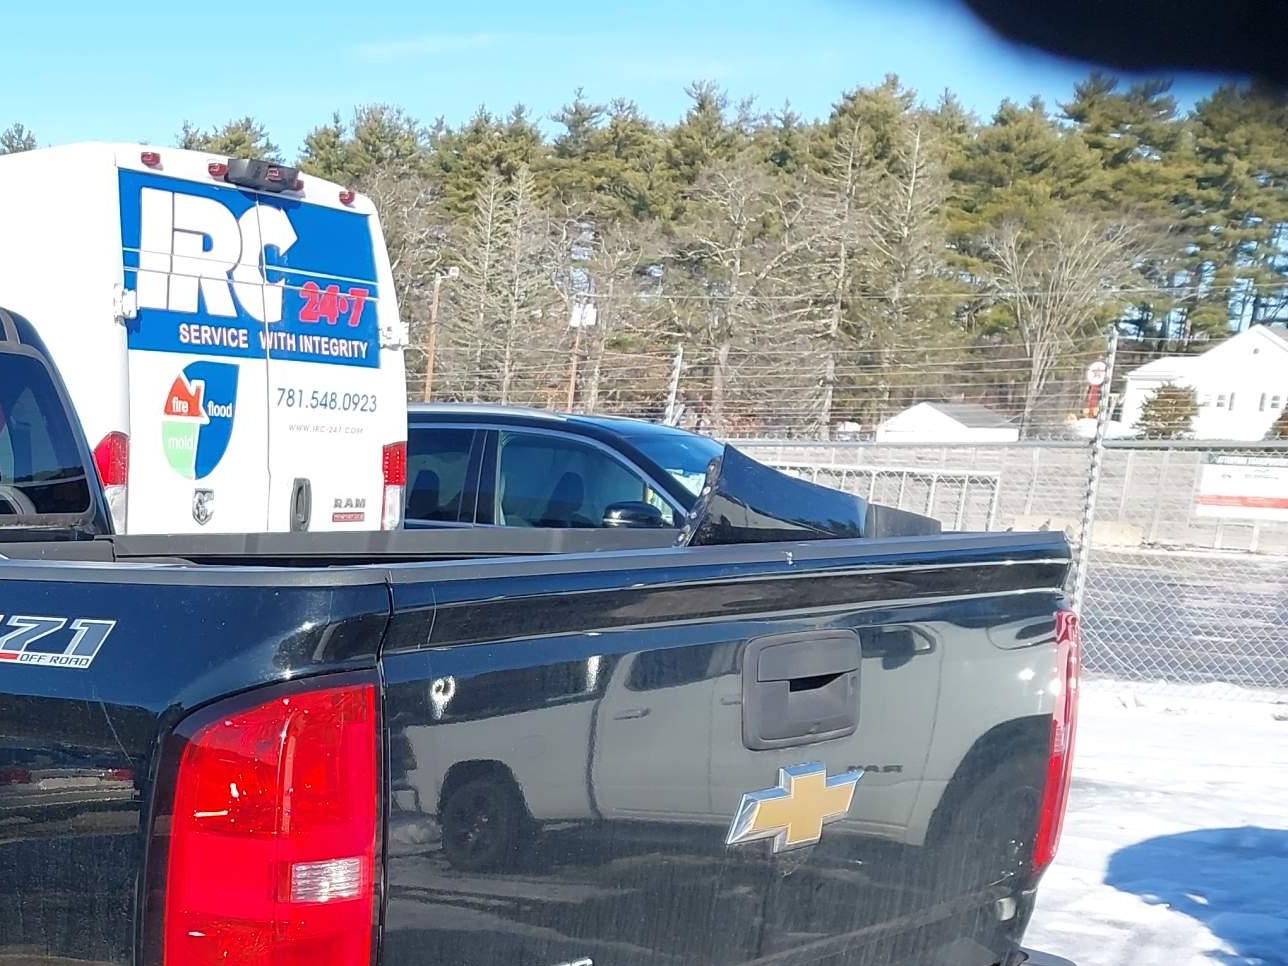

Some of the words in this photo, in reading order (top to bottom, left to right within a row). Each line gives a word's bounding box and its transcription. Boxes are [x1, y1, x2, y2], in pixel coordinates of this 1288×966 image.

[136, 187, 298, 323] IRC
[179, 323, 249, 348] SERVICE
[259, 331, 296, 351] WITH
[299, 337, 368, 359] INTEGRITY
[172, 397, 189, 413] fire
[277, 387, 377, 413] 781.548.0923
[207, 400, 233, 418] flood
[168, 436, 194, 450] mold
[334, 498, 366, 509] RAM
[19, 652, 48, 664] OFF
[49, 656, 90, 667] ROAD
